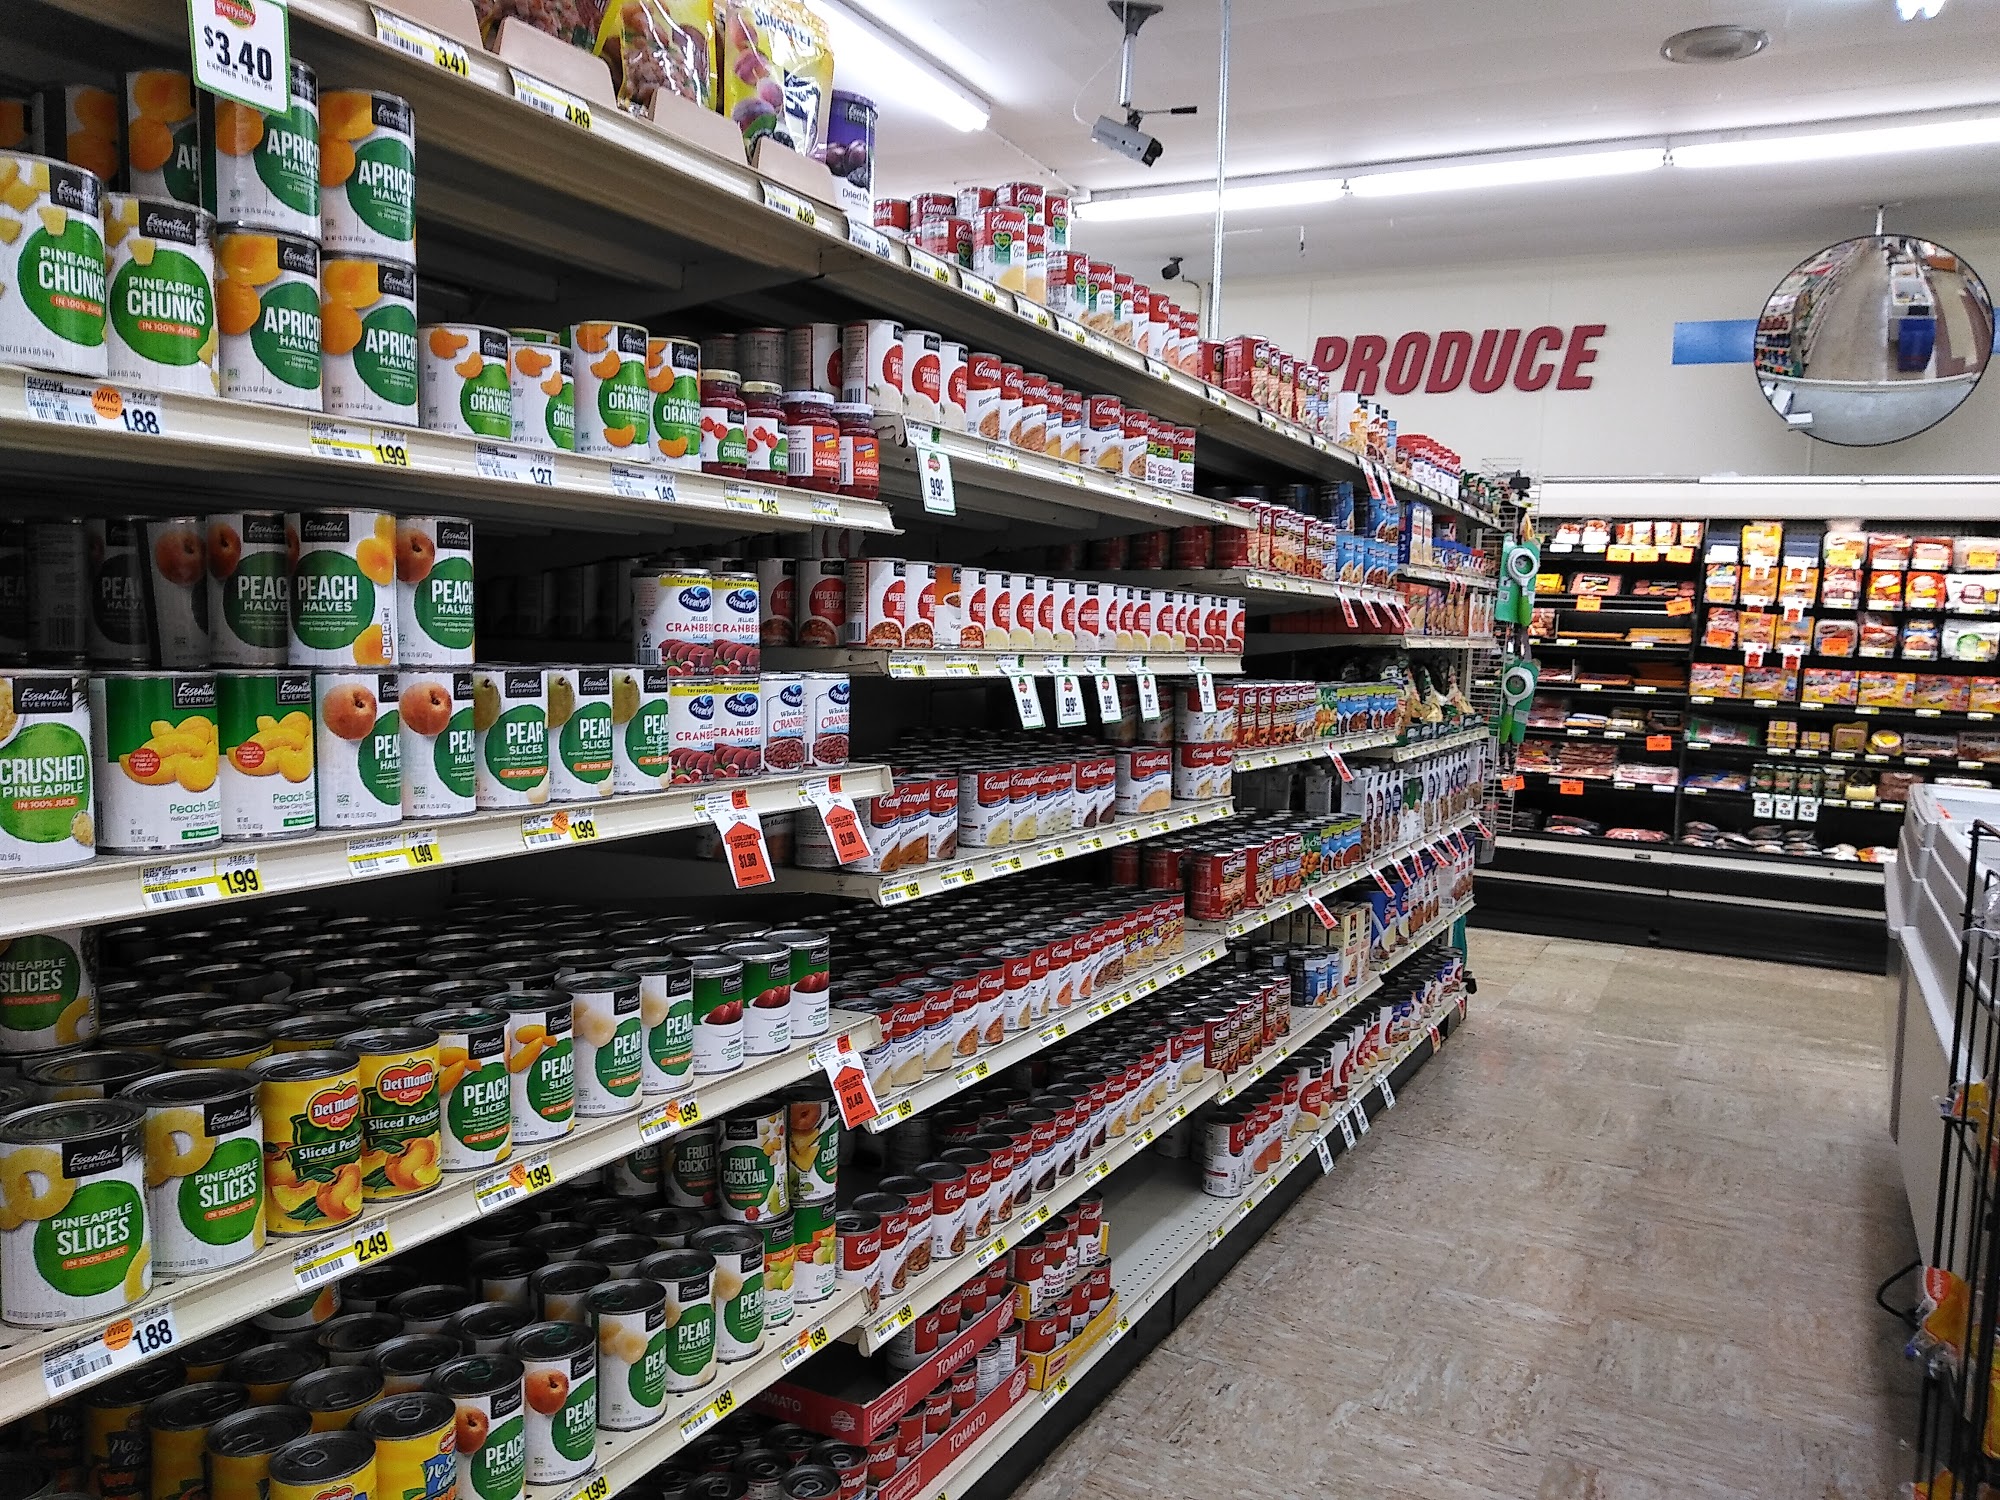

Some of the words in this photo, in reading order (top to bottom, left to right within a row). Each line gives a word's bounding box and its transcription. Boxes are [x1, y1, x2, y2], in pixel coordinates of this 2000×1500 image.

[204, 24, 272, 81] $3.40
[439, 46, 467, 76] 3.41
[565, 103, 590, 129] 4.89
[267, 129, 319, 170] APRICO
[283, 159, 319, 181] HALVE
[147, 213, 191, 232] Essential
[39, 261, 105, 303] CHUNKS
[129, 276, 204, 299] PINEAPPLE
[127, 289, 205, 326] CHUNKS
[1311, 324, 1606, 396] PRODUCE
[95, 390, 119, 404] WIC
[470, 395, 511, 413] ORANGE
[609, 392, 650, 412] ORANGE
[121, 408, 160, 434] 1.88
[553, 410, 574, 427] ORAN
[663, 405, 700, 425] ORANGE
[376, 444, 406, 466] 1.99
[305, 520, 343, 533] Essential
[237, 575, 287, 599] PEAC
[298, 575, 358, 601] PEACH
[431, 579, 473, 604] PEACH
[302, 601, 352, 612] HALVES
[437, 604, 472, 615] HALVES
[21, 687, 67, 701] Essential
[177, 682, 215, 698] Essential
[510, 678, 539, 689] Essential
[506, 721, 544, 744] PEAR
[580, 718, 611, 740] PEAR
[374, 734, 400, 761] PEA
[450, 731, 475, 754] PEA
[509, 745, 543, 755] SLICES
[582, 739, 610, 749] SLICES
[0, 755, 84, 784] CRUSHED
[2, 782, 83, 798] PINEAPPLE
[272, 792, 303, 803] Peach
[17, 800, 27, 809] IN
[29, 799, 53, 809] 100%
[55, 798, 76, 807] JUICE
[169, 803, 206, 814] Peach
[571, 819, 595, 839] 1.99
[411, 845, 433, 862] 1.99
[734, 841, 756, 849] SPECIAL
[222, 869, 259, 894] 1.99
[906, 882, 920, 897] 1.99
[0, 970, 62, 993] SLICES
[473, 1038, 502, 1051] Essential
[383, 1079, 401, 1091] Del
[403, 1072, 432, 1089] Monte
[463, 1077, 510, 1107] PEACH
[210, 1108, 248, 1125] Essential
[314, 1103, 334, 1116] Del
[369, 1116, 404, 1130] Sliced
[408, 1108, 439, 1126] Peaches
[472, 1101, 505, 1117] SLICES
[679, 1101, 698, 1122] 1.99
[69, 1146, 117, 1166] Essential
[299, 1145, 337, 1159] Sliced
[339, 1134, 361, 1151] Peach
[71, 1157, 120, 1173] EVERYDAY
[194, 1159, 258, 1186] PINEAPPLE
[729, 1157, 757, 1171] FRUIT
[527, 1164, 551, 1188] 1.99
[723, 1169, 768, 1183] COCKTAIL
[200, 1172, 257, 1208] SLICES
[51, 1202, 133, 1230] PINEAPPLE
[57, 1217, 130, 1255] SLICES
[354, 1231, 388, 1261] 2.49
[66, 1259, 76, 1268] IN
[79, 1254, 101, 1266] 100%
[106, 1324, 129, 1337] WIC
[132, 1318, 173, 1354] 1.88
[678, 1318, 710, 1343] PEAR
[810, 1326, 828, 1348] 1.99
[678, 1336, 711, 1352] HALVES
[936, 1339, 974, 1378] TOMATO
[713, 1389, 733, 1413] 1.99
[950, 1412, 986, 1452] TOMATO
